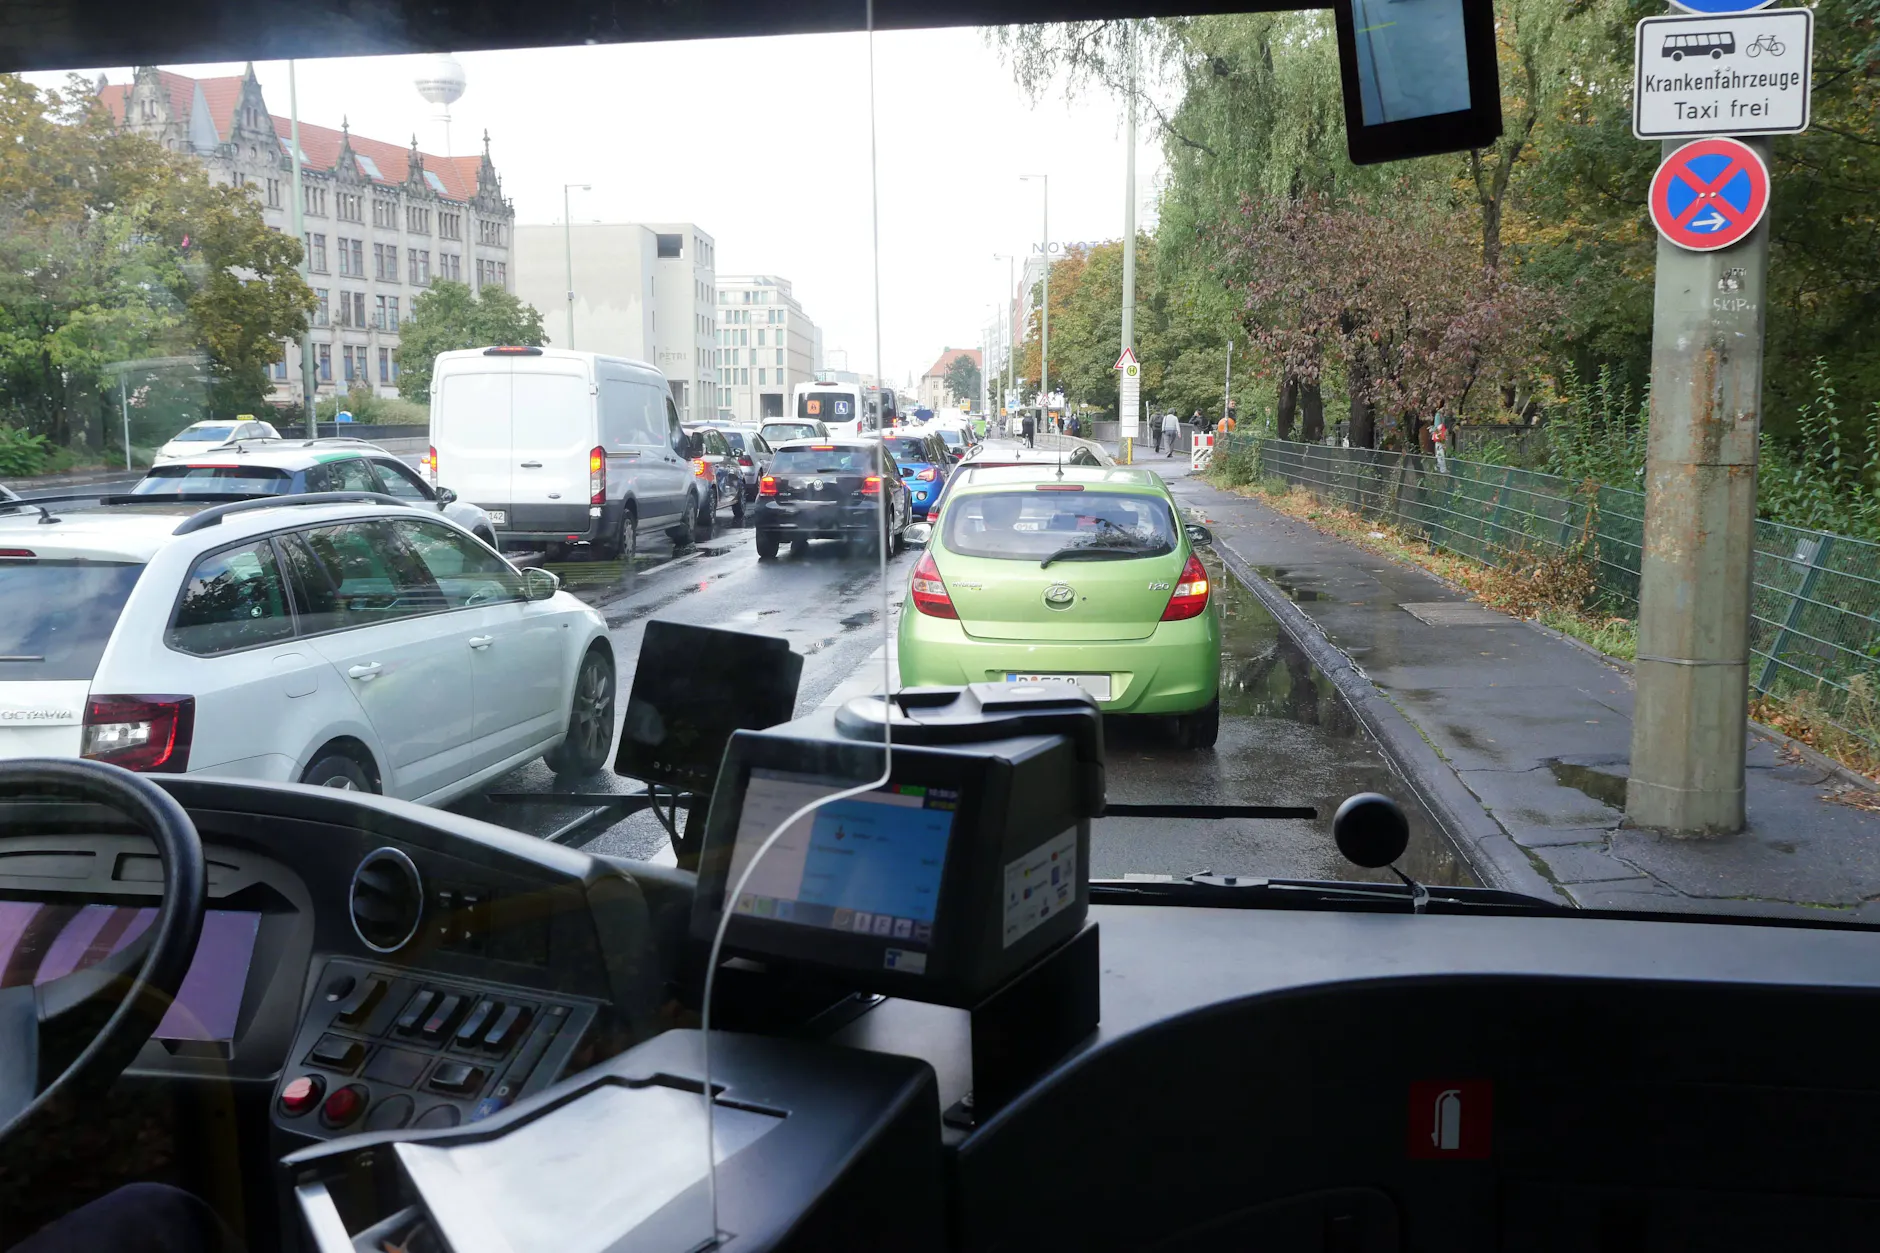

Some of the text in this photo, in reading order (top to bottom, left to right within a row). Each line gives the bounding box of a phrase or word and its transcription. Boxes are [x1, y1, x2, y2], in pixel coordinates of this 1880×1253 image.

[1645, 72, 1800, 93] Krankenfahrzeuge
[1674, 98, 1769, 120] Taxi frei
[659, 352, 687, 361] PETRI
[489, 512, 503, 521] 142
[1148, 582, 1170, 591] i20
[1, 710, 73, 720] OCTAVIA
